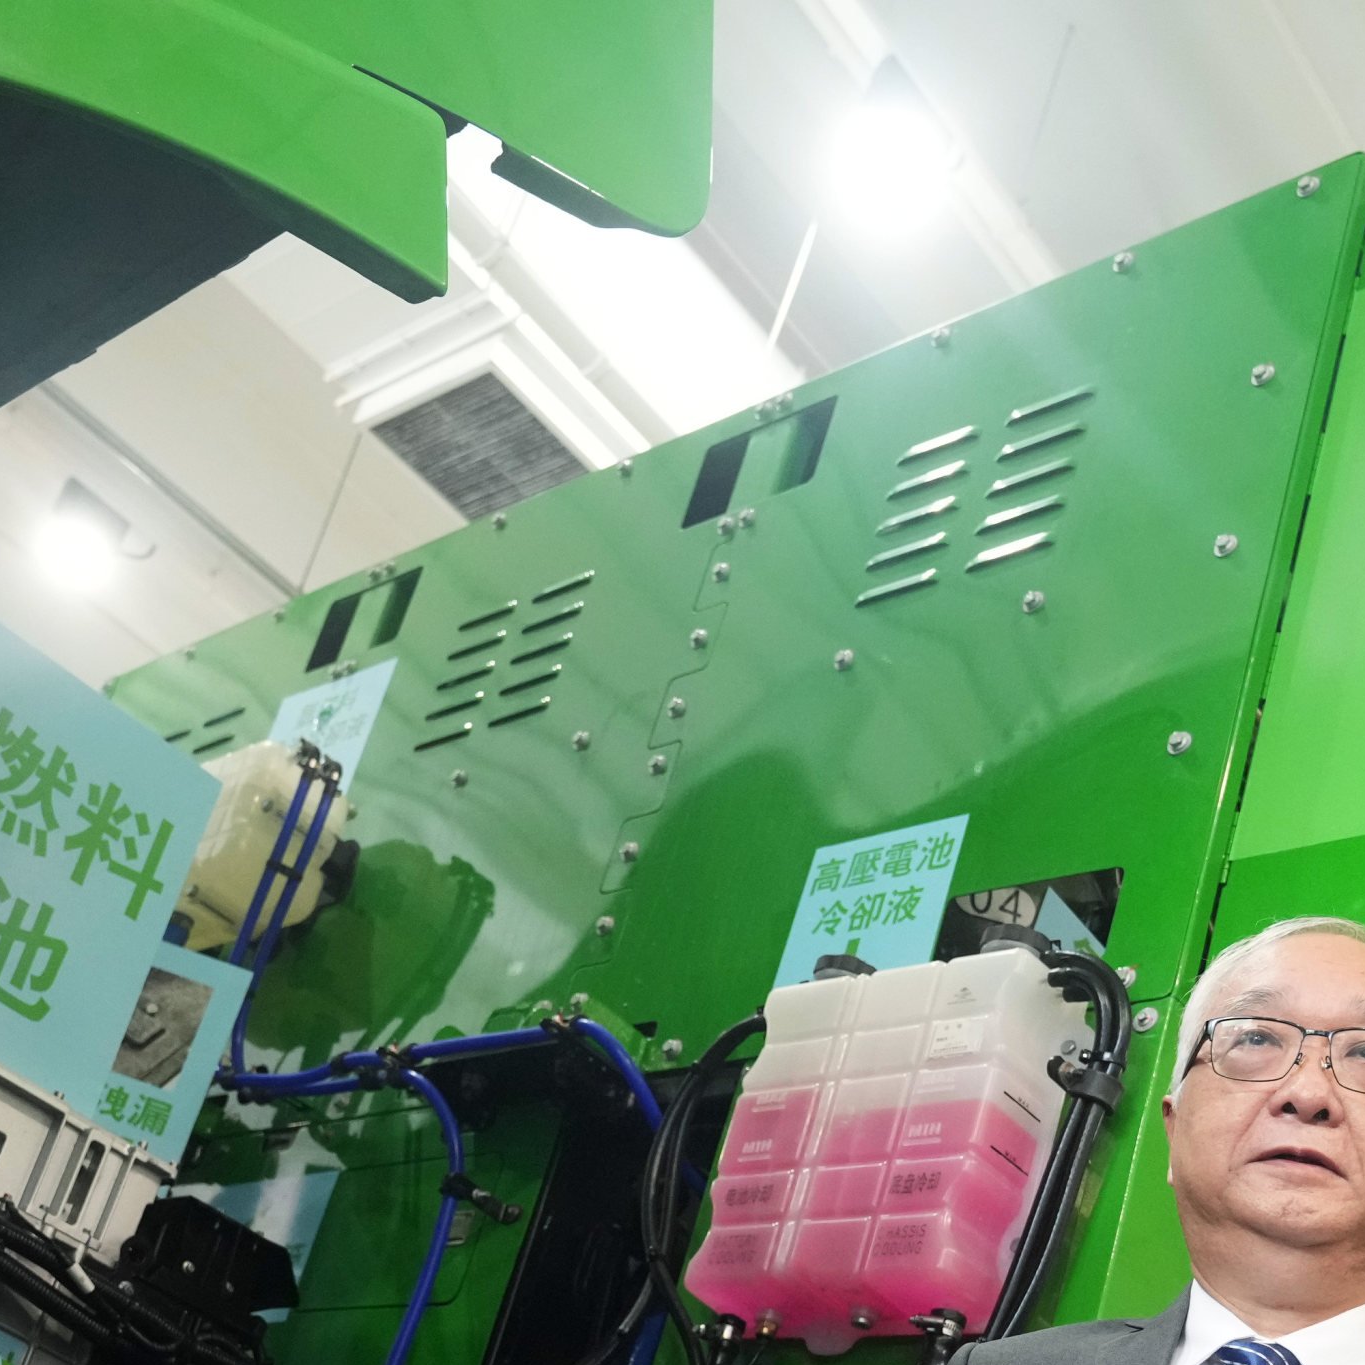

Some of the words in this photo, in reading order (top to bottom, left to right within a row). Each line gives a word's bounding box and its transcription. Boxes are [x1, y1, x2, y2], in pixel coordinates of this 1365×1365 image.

[809, 831, 956, 897] 高壓電池
[811, 885, 925, 936] 冷卻液
